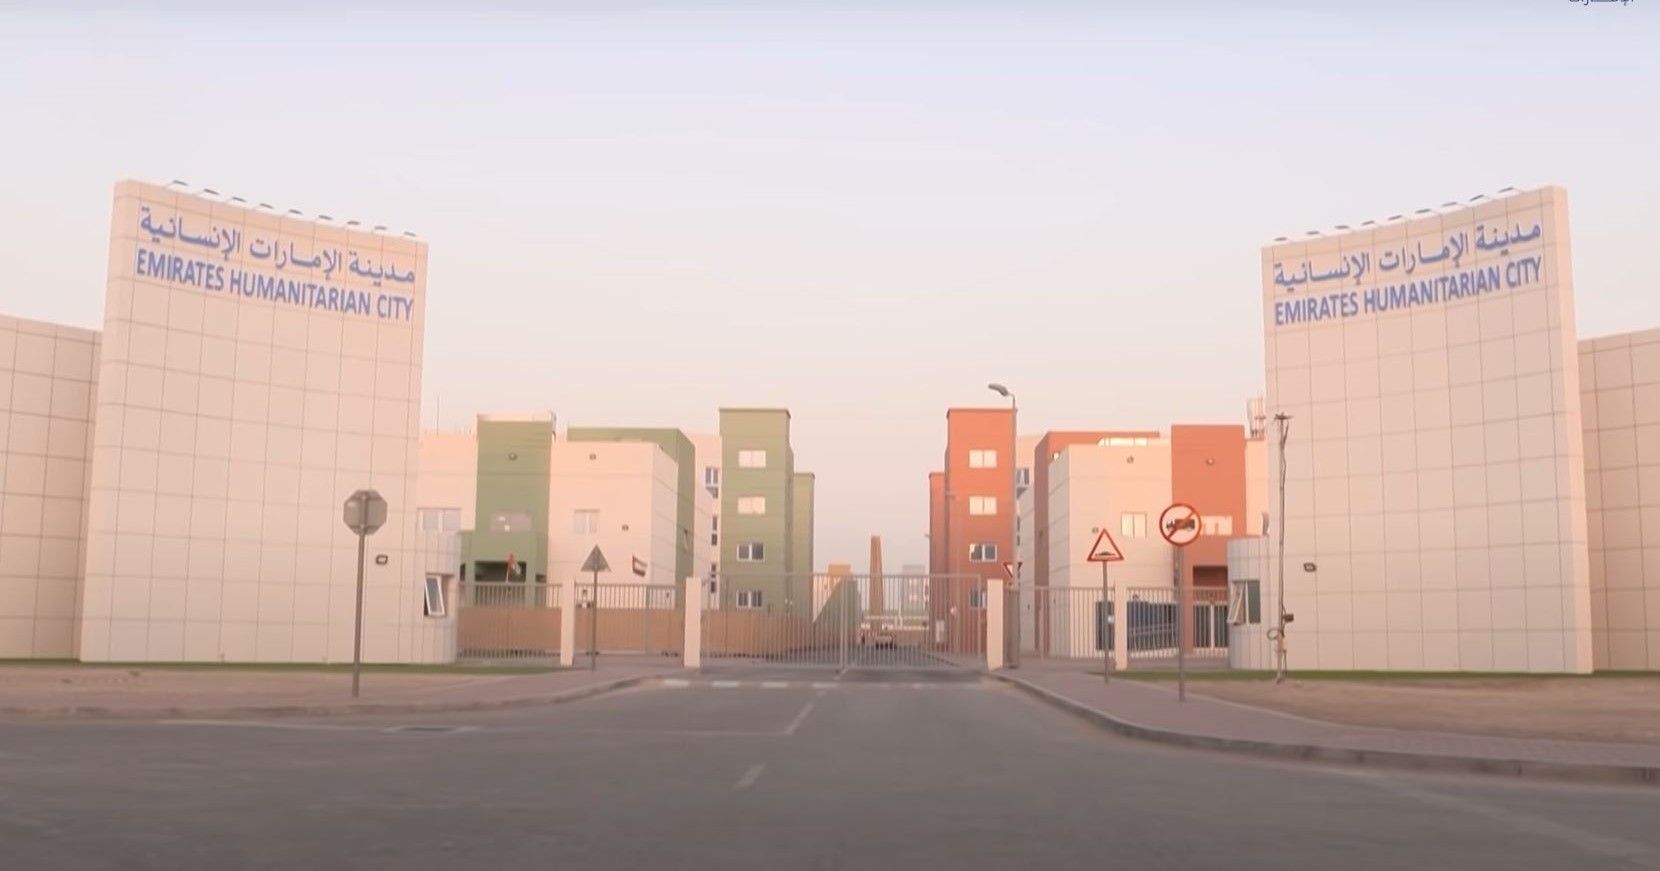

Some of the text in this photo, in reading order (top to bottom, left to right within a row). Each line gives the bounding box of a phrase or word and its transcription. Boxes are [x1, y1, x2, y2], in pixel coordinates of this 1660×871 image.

[1475, 222, 1541, 256] مدينة
[136, 248, 414, 322] EMIRATES HUMANITARIAN CITY
[349, 249, 416, 287] مدينة
[1274, 256, 1542, 326] EMIRATES HUMANITARIAN CITY
